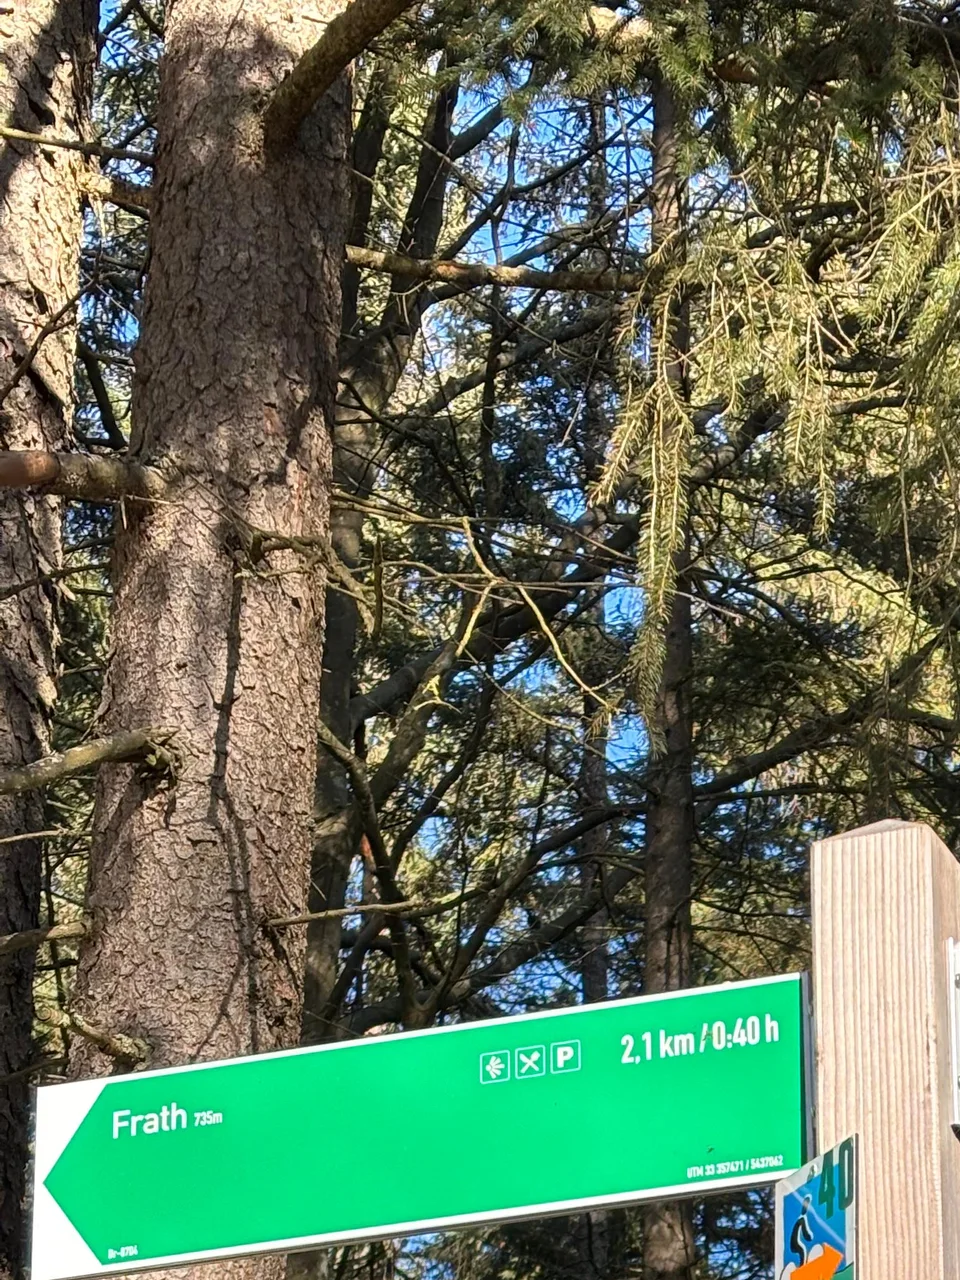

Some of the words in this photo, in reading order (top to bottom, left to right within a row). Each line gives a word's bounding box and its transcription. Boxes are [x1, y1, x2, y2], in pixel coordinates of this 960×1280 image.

[620, 1031, 652, 1064] 2,1
[112, 1102, 187, 1139] Frath
[194, 1110, 222, 1127] 735m
[687, 1166, 704, 1178] UTM
[818, 1136, 854, 1219] 40
